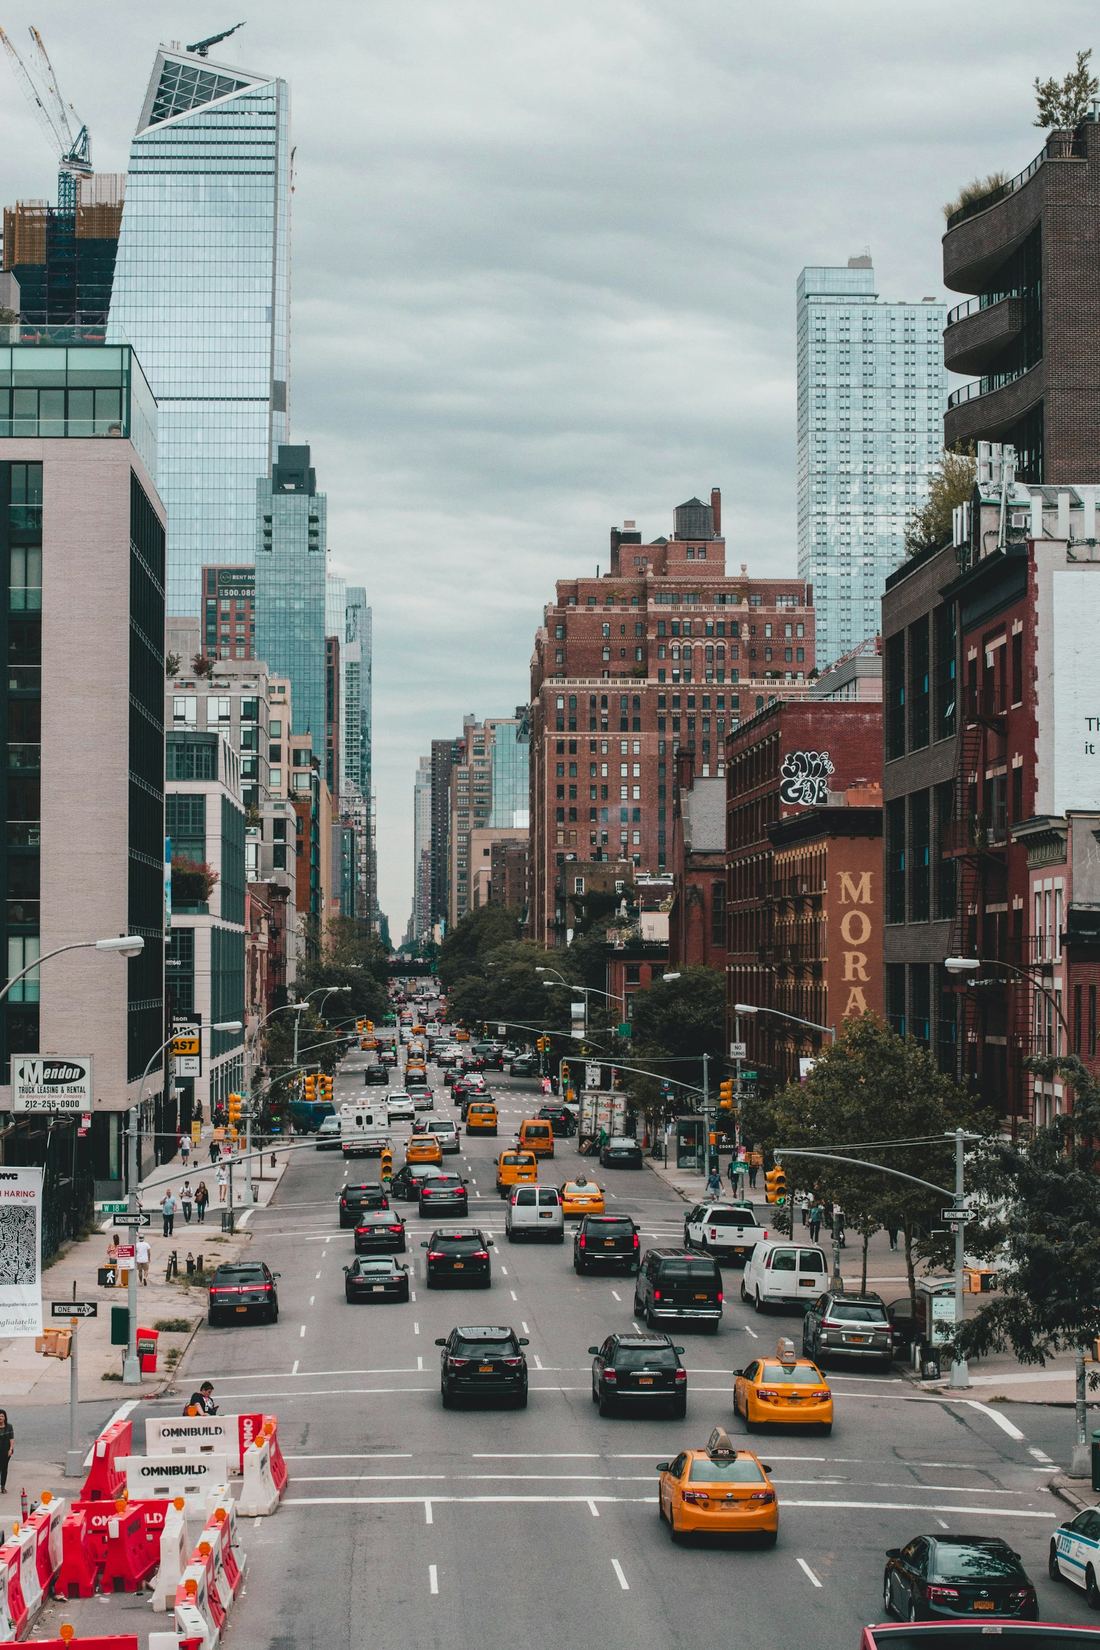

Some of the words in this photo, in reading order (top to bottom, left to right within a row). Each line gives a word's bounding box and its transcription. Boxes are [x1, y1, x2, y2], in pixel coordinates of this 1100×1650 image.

[1084, 741, 1095, 755] it
[836, 871, 874, 1016] MORA
[23, 1060, 80, 1086] Mendon
[4, 1190, 36, 1198] HARING
[112, 1204, 120, 1212] 18
[161, 1426, 223, 1438] OMNIBUILD
[140, 1464, 207, 1477] OMNIBUILD
